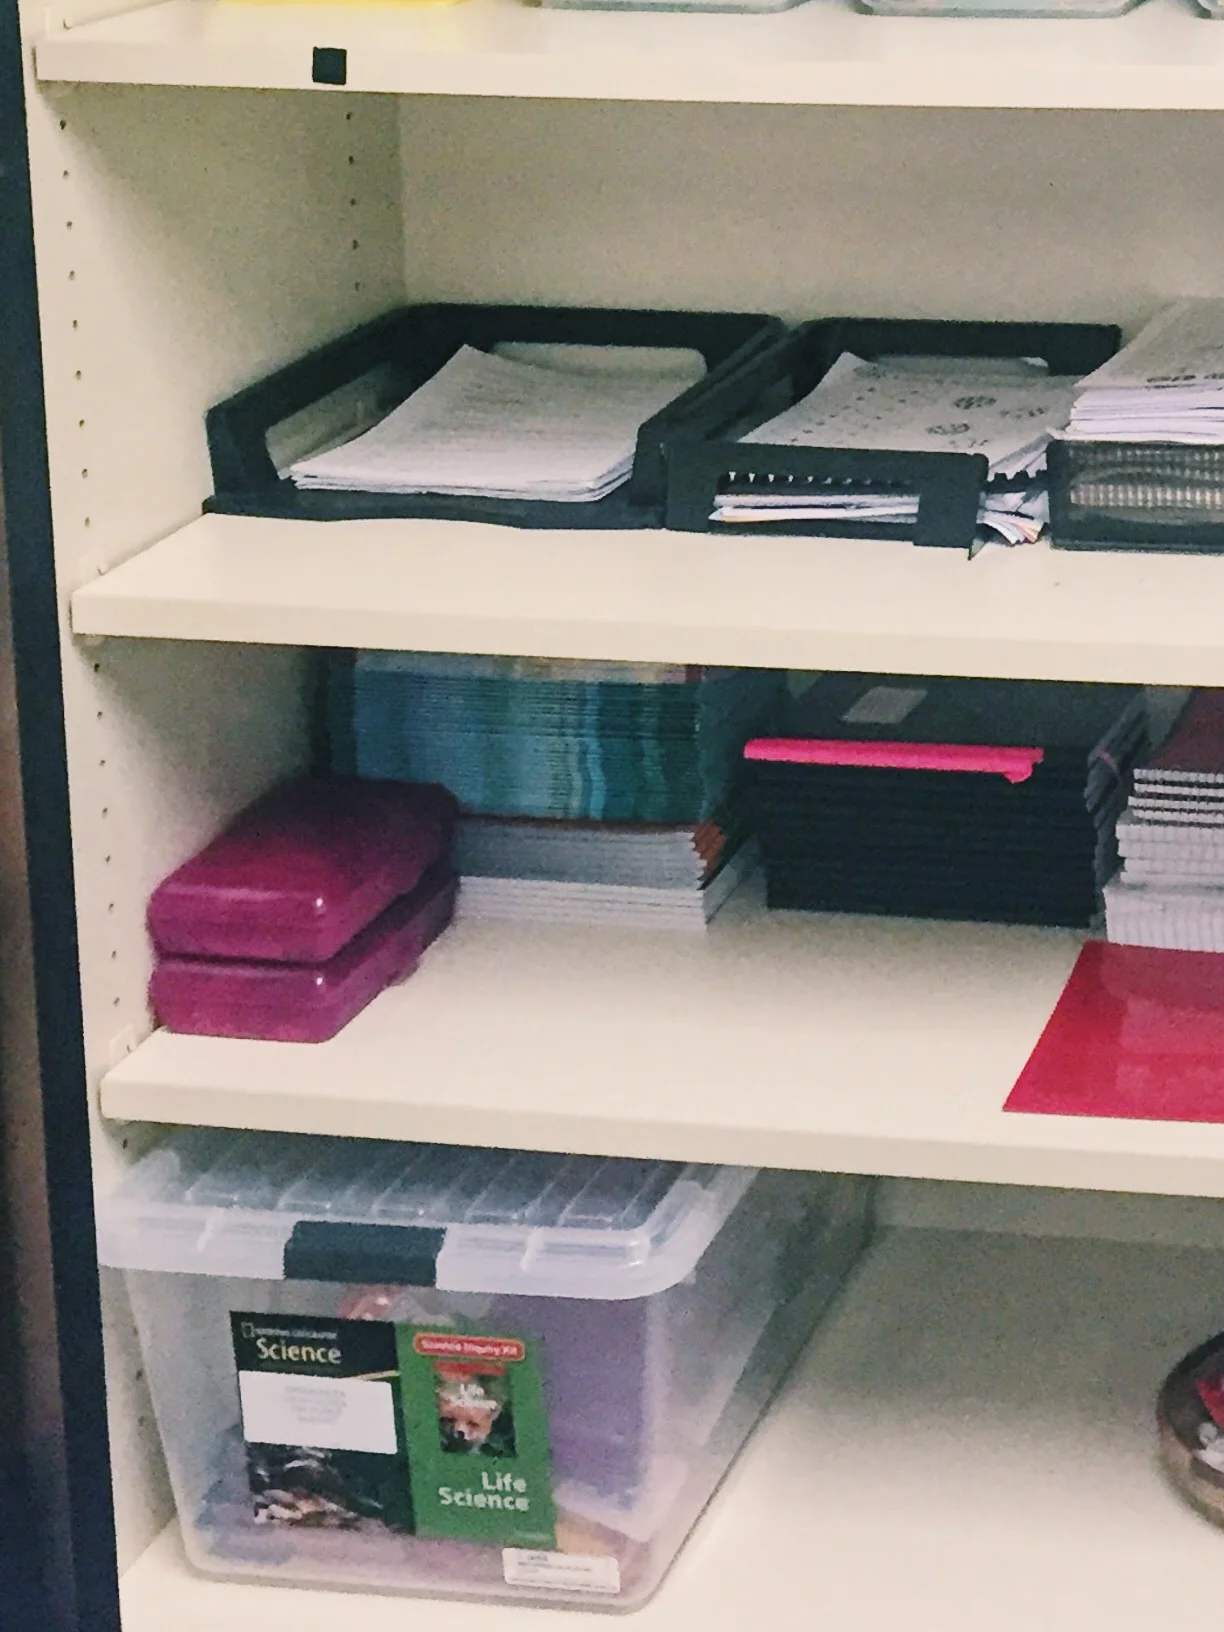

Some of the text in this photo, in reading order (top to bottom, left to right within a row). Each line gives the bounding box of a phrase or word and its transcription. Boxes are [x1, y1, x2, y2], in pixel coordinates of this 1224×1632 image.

[256, 1336, 343, 1364] Science
[481, 1471, 528, 1494] Life
[437, 1486, 530, 1512] Science
